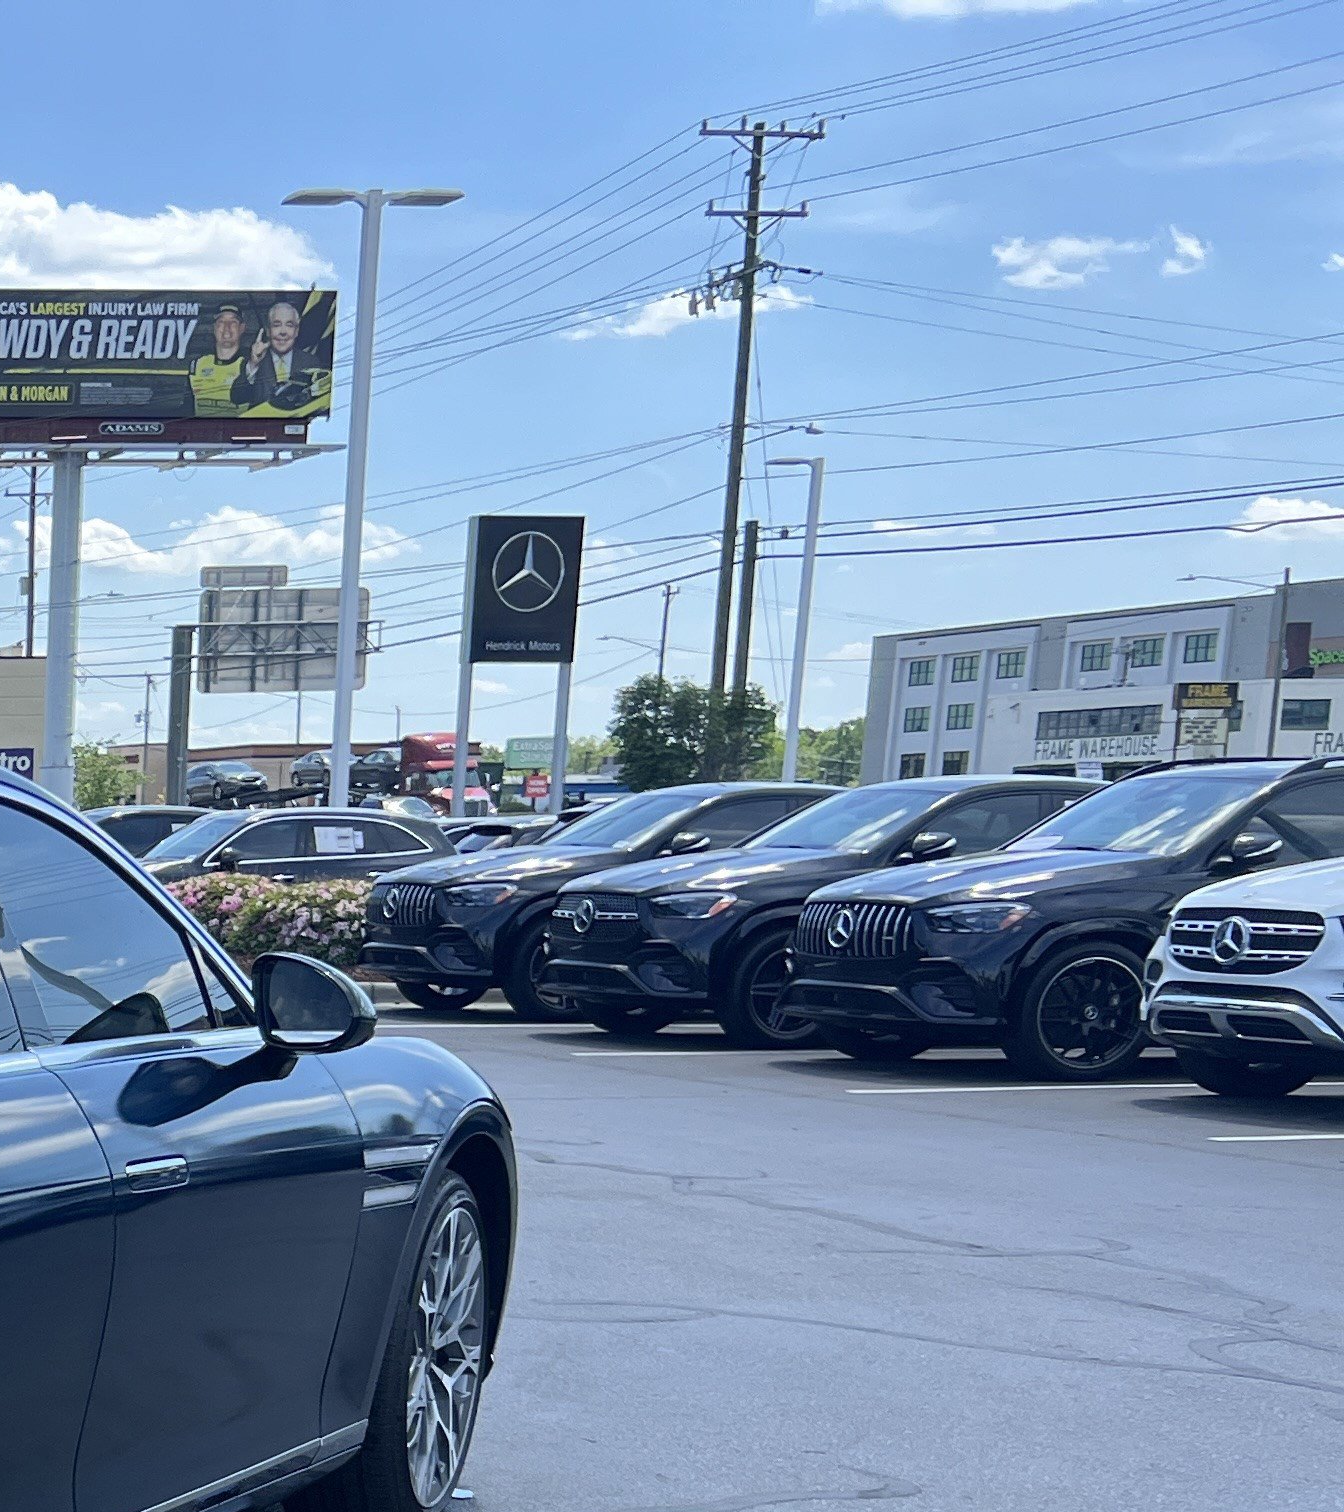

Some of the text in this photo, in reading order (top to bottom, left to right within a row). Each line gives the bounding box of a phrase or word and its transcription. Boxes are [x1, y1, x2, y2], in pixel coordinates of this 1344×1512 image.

[30, 301, 87, 316] LARGEST
[88, 301, 136, 316] INJURY
[136, 301, 165, 316] LAW
[166, 301, 200, 316] FIRM
[69, 318, 94, 360] &
[96, 318, 198, 360] READY
[10, 385, 18, 401] &
[20, 385, 69, 402] MORGAN
[104, 423, 160, 433] ADAMS
[485, 640, 561, 651] Hendrick Motors
[1034, 735, 1158, 761] FRAME WAREHOUSE
